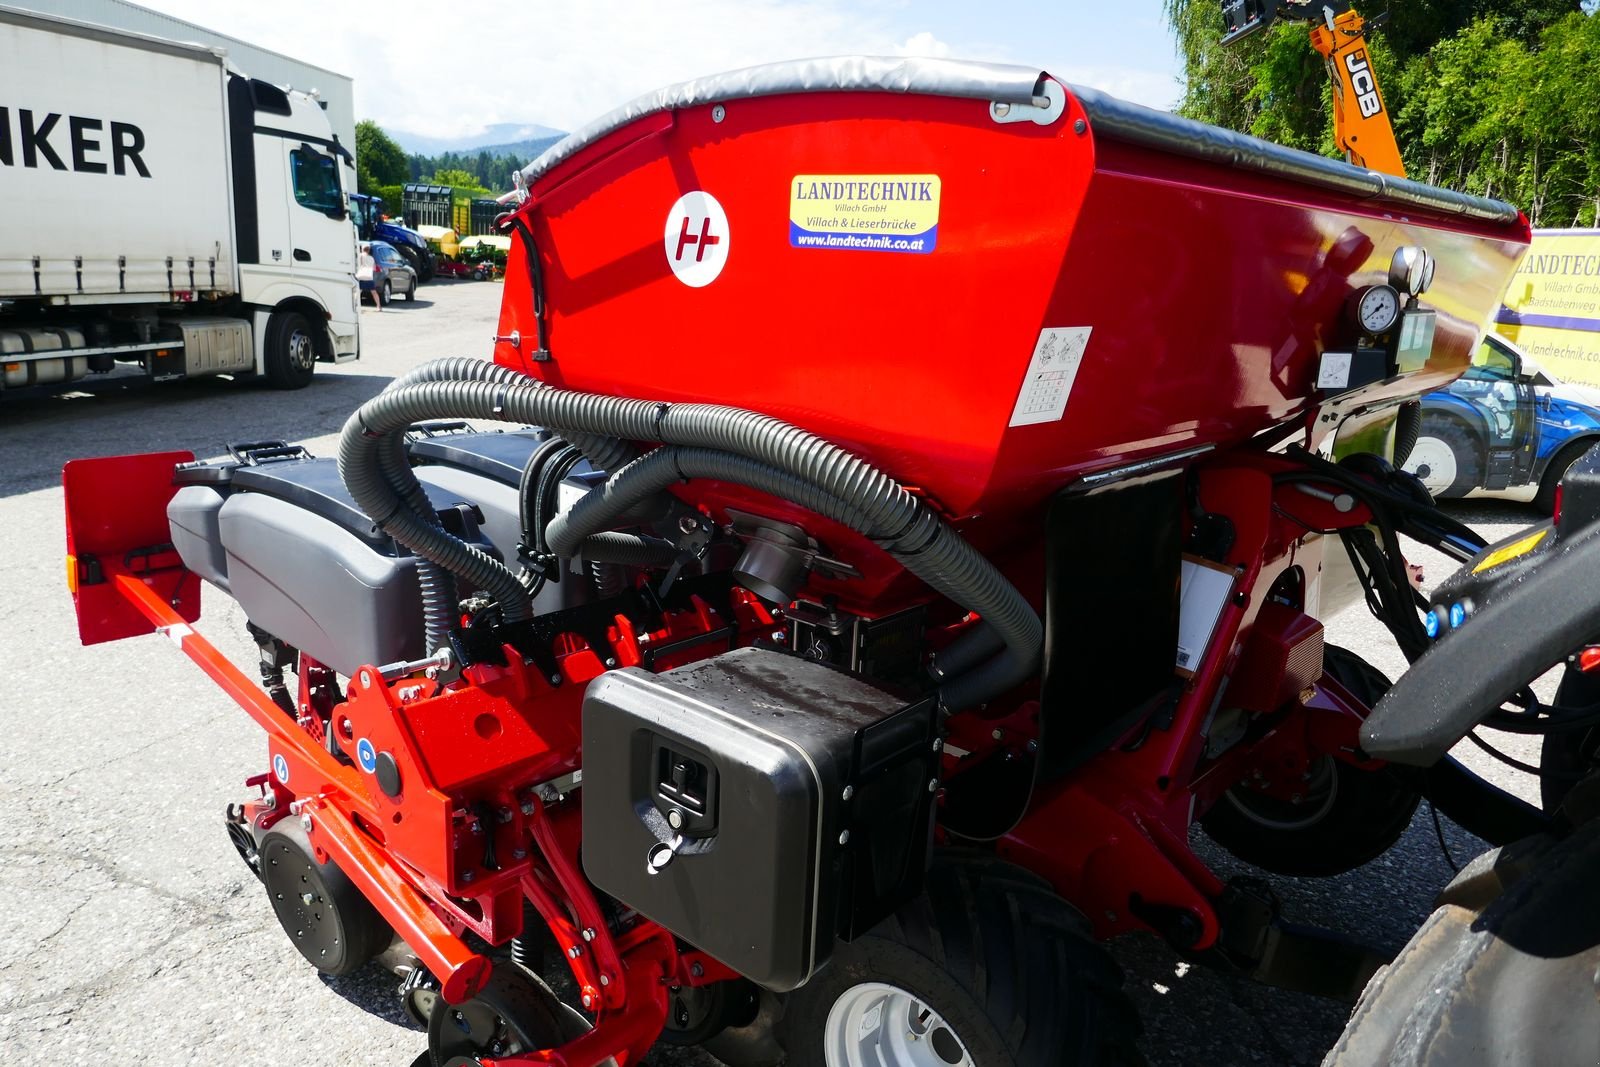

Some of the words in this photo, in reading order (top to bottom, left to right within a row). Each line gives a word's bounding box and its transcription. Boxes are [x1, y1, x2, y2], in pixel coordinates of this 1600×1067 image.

[1346, 54, 1380, 118] JCB
[797, 182, 932, 201] LANDTECHNIK
[835, 204, 860, 212] Villach
[862, 204, 887, 213] GmbH
[807, 217, 838, 228] Villach
[841, 218, 848, 227] &
[851, 218, 916, 230] Lieserbrücke
[798, 234, 924, 250] www.landtechnik.co.at
[1516, 254, 1600, 276] ANDTEC
[1544, 281, 1572, 293] Villach
[1575, 283, 1600, 294] Gmb
